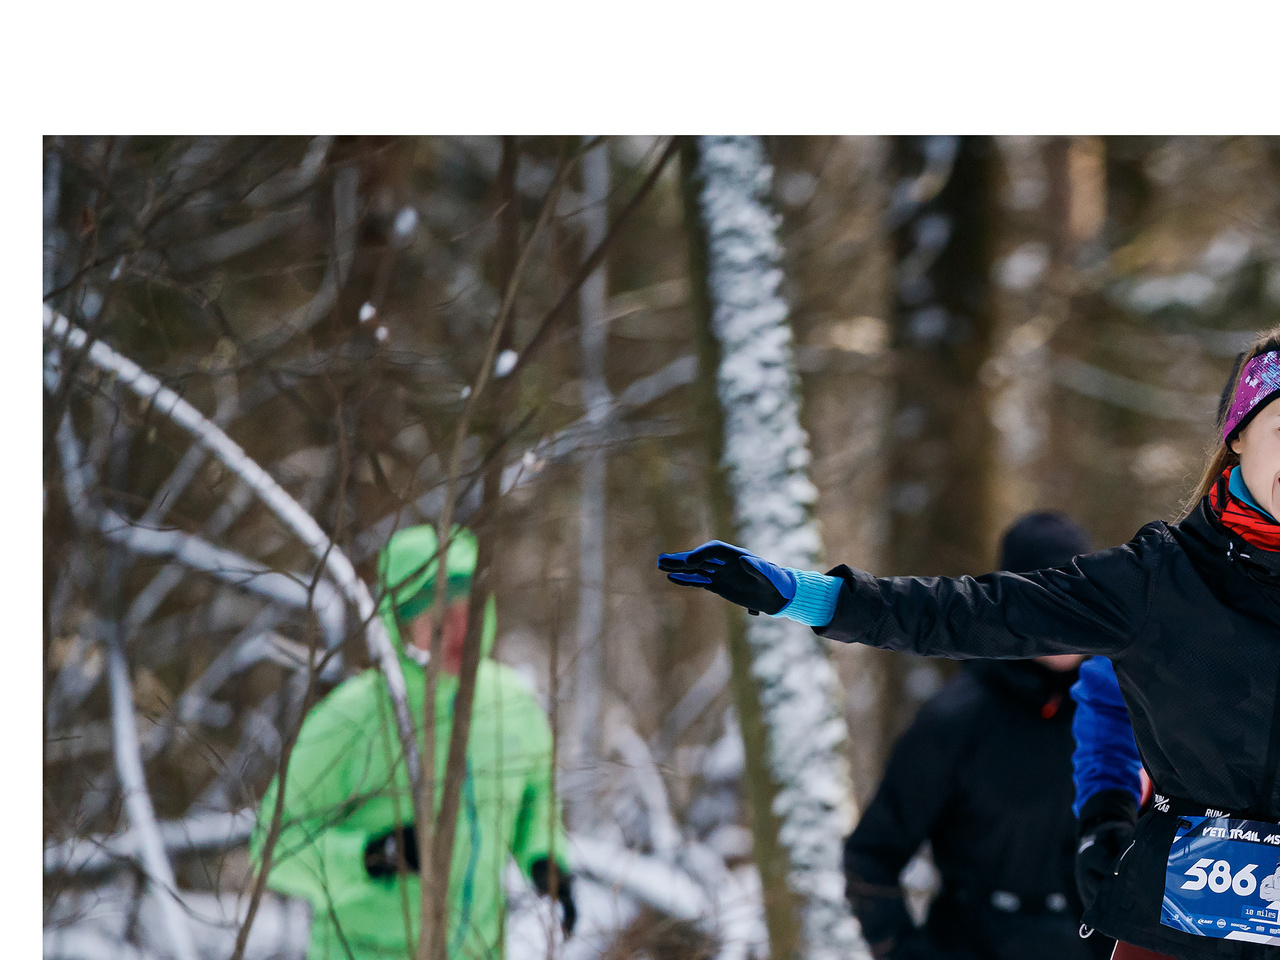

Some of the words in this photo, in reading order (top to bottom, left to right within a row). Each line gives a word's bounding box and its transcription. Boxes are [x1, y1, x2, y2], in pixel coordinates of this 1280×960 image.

[1205, 809, 1223, 818] RUN
[1202, 827, 1226, 838] YETI
[1229, 828, 1260, 842] TRAIL
[1180, 858, 1259, 896] 586
[1245, 908, 1254, 916] 10
[1256, 910, 1277, 919] miles
